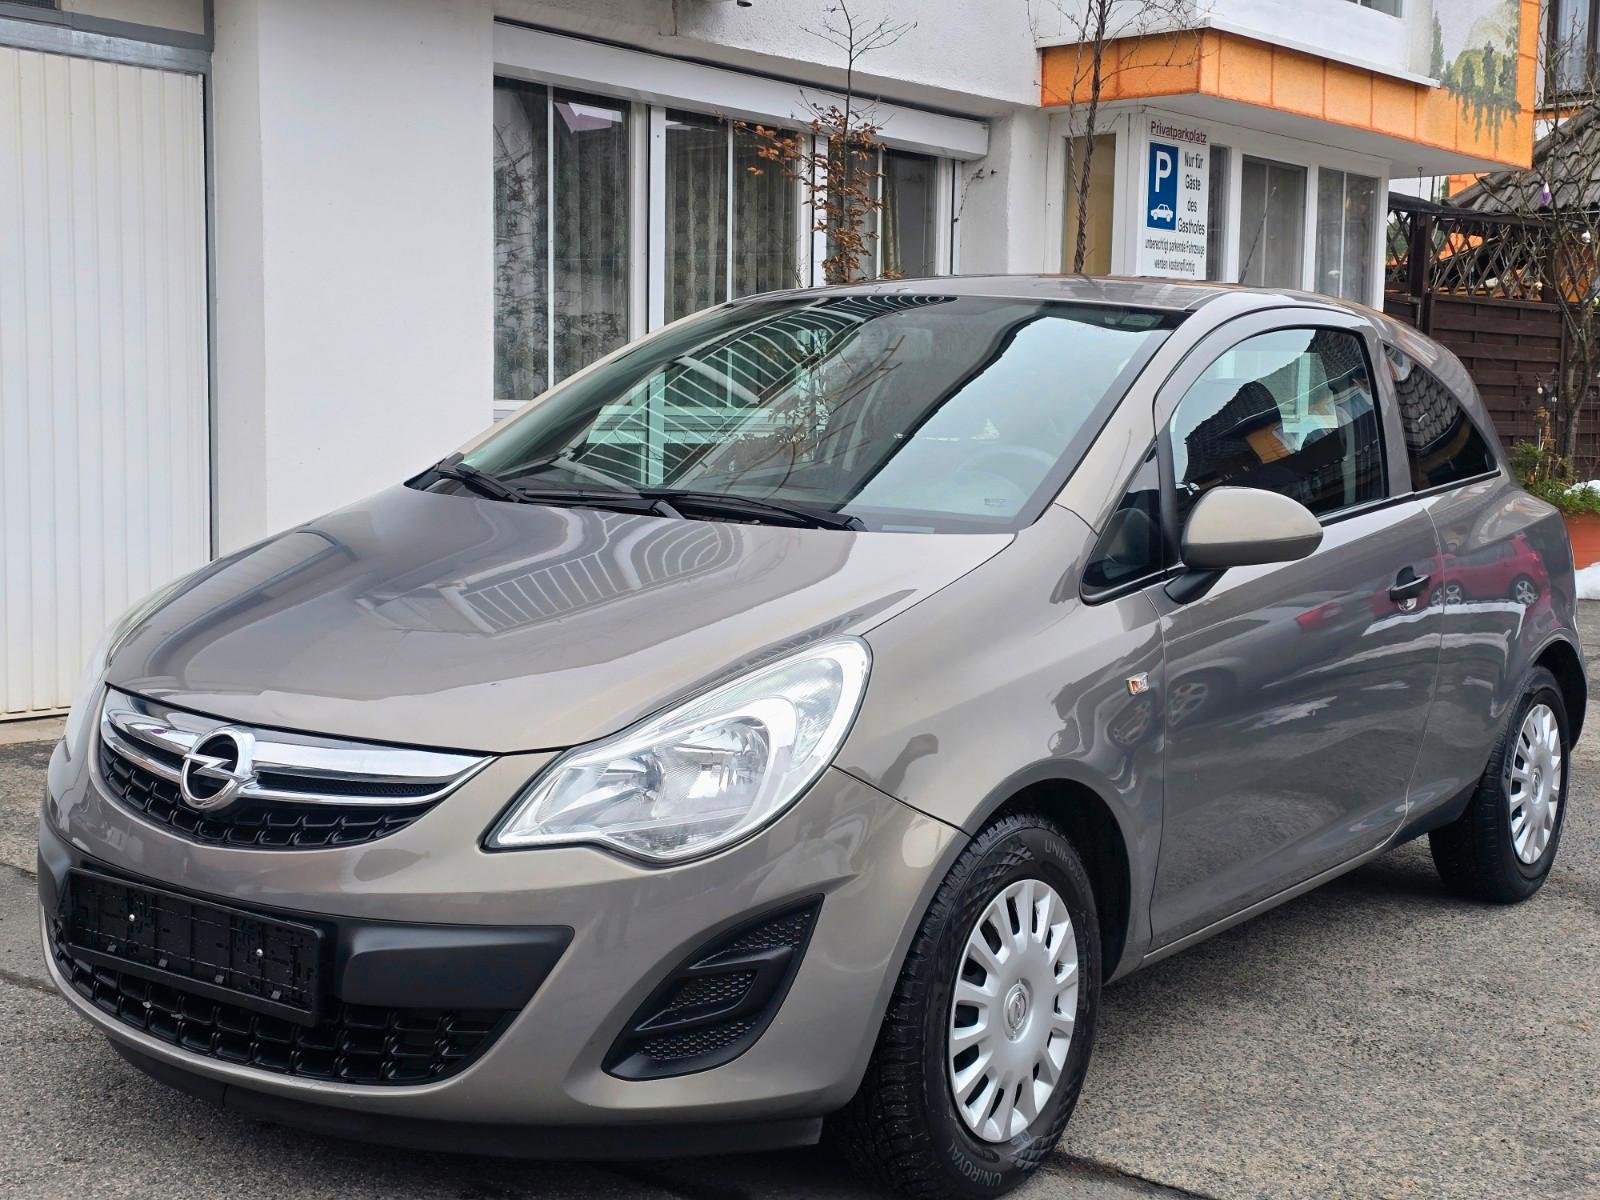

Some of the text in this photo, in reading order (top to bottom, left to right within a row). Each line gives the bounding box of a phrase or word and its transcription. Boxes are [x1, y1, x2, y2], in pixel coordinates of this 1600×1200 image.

[1151, 120, 1207, 144] Privatparkplatz
[1185, 152, 1204, 168] Nur für
[1155, 151, 1172, 192] P
[1185, 174, 1201, 191] Gäste
[1187, 197, 1197, 213] des
[1178, 217, 1205, 235] Gasthofes
[947, 1138, 1002, 1187] UNIROYAL
